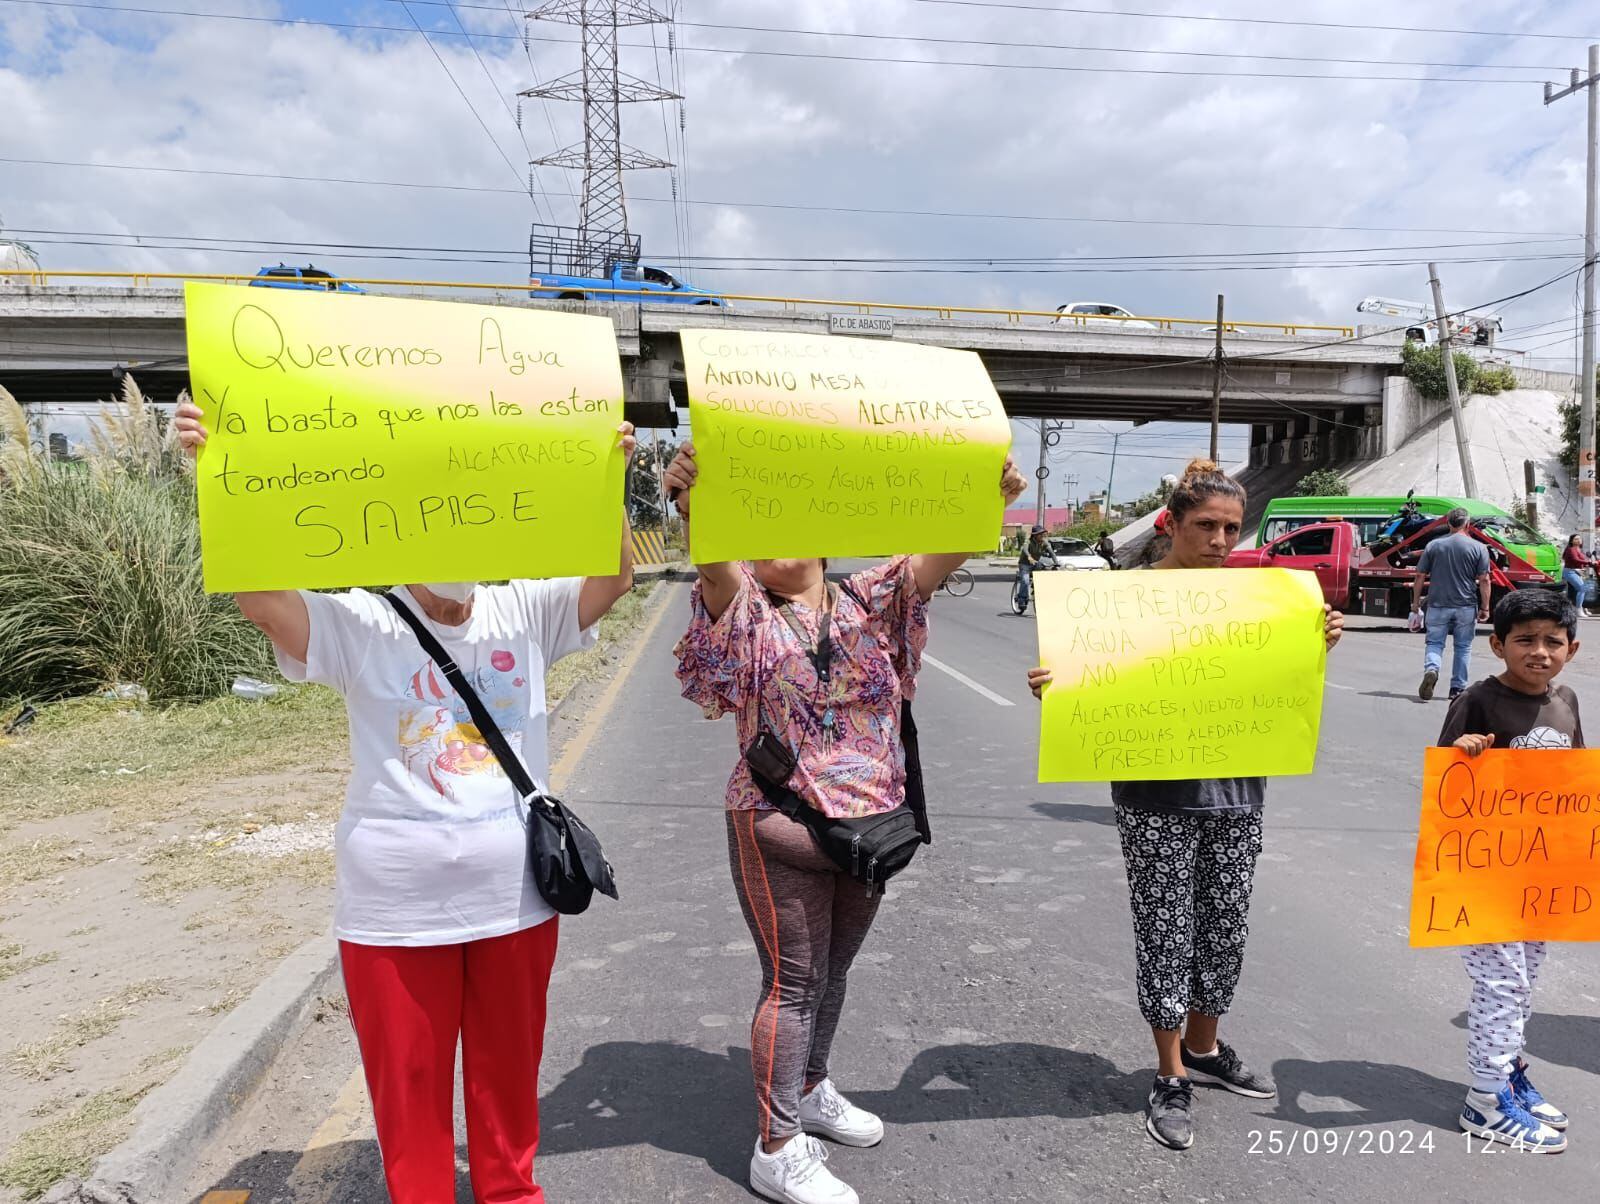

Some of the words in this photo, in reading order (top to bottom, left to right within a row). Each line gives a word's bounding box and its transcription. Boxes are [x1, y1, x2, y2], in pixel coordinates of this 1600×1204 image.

[232, 304, 442, 373] Queremos
[479, 317, 565, 375] Agua
[832, 317, 846, 328] P.C.
[847, 318, 856, 328] DE
[858, 318, 891, 330] ABASTOS
[704, 363, 797, 391] ANTONIO
[809, 371, 866, 390] MESA
[203, 385, 247, 434] Ya
[265, 395, 358, 433] basta
[378, 408, 425, 440] que
[437, 404, 479, 421] nos
[489, 390, 522, 416] las
[540, 387, 609, 416] estan
[706, 391, 840, 425] SOLUCIONES
[858, 399, 992, 424] ALCATRACES
[718, 425, 728, 452] Y
[447, 439, 598, 472] ALCATRACES
[214, 453, 385, 496] tandeando
[728, 456, 815, 490] EXIGIMOS
[827, 465, 875, 492] AGUA
[884, 465, 923, 488] POR
[943, 469, 972, 492] LA
[731, 488, 783, 519] RED
[889, 496, 965, 517] PIPITAS
[1066, 584, 1228, 619] QUEREMOS
[1070, 625, 1136, 654] AGUA
[1080, 662, 1117, 688] NO
[1144, 656, 1227, 688] PIPAS
[1078, 731, 1087, 749] Y
[1094, 727, 1175, 746] COLONIAS
[1092, 744, 1229, 770] PRESENTES
[1436, 826, 1549, 873] AGUA
[1427, 895, 1470, 933] LA
[1521, 885, 1592, 919] RED
